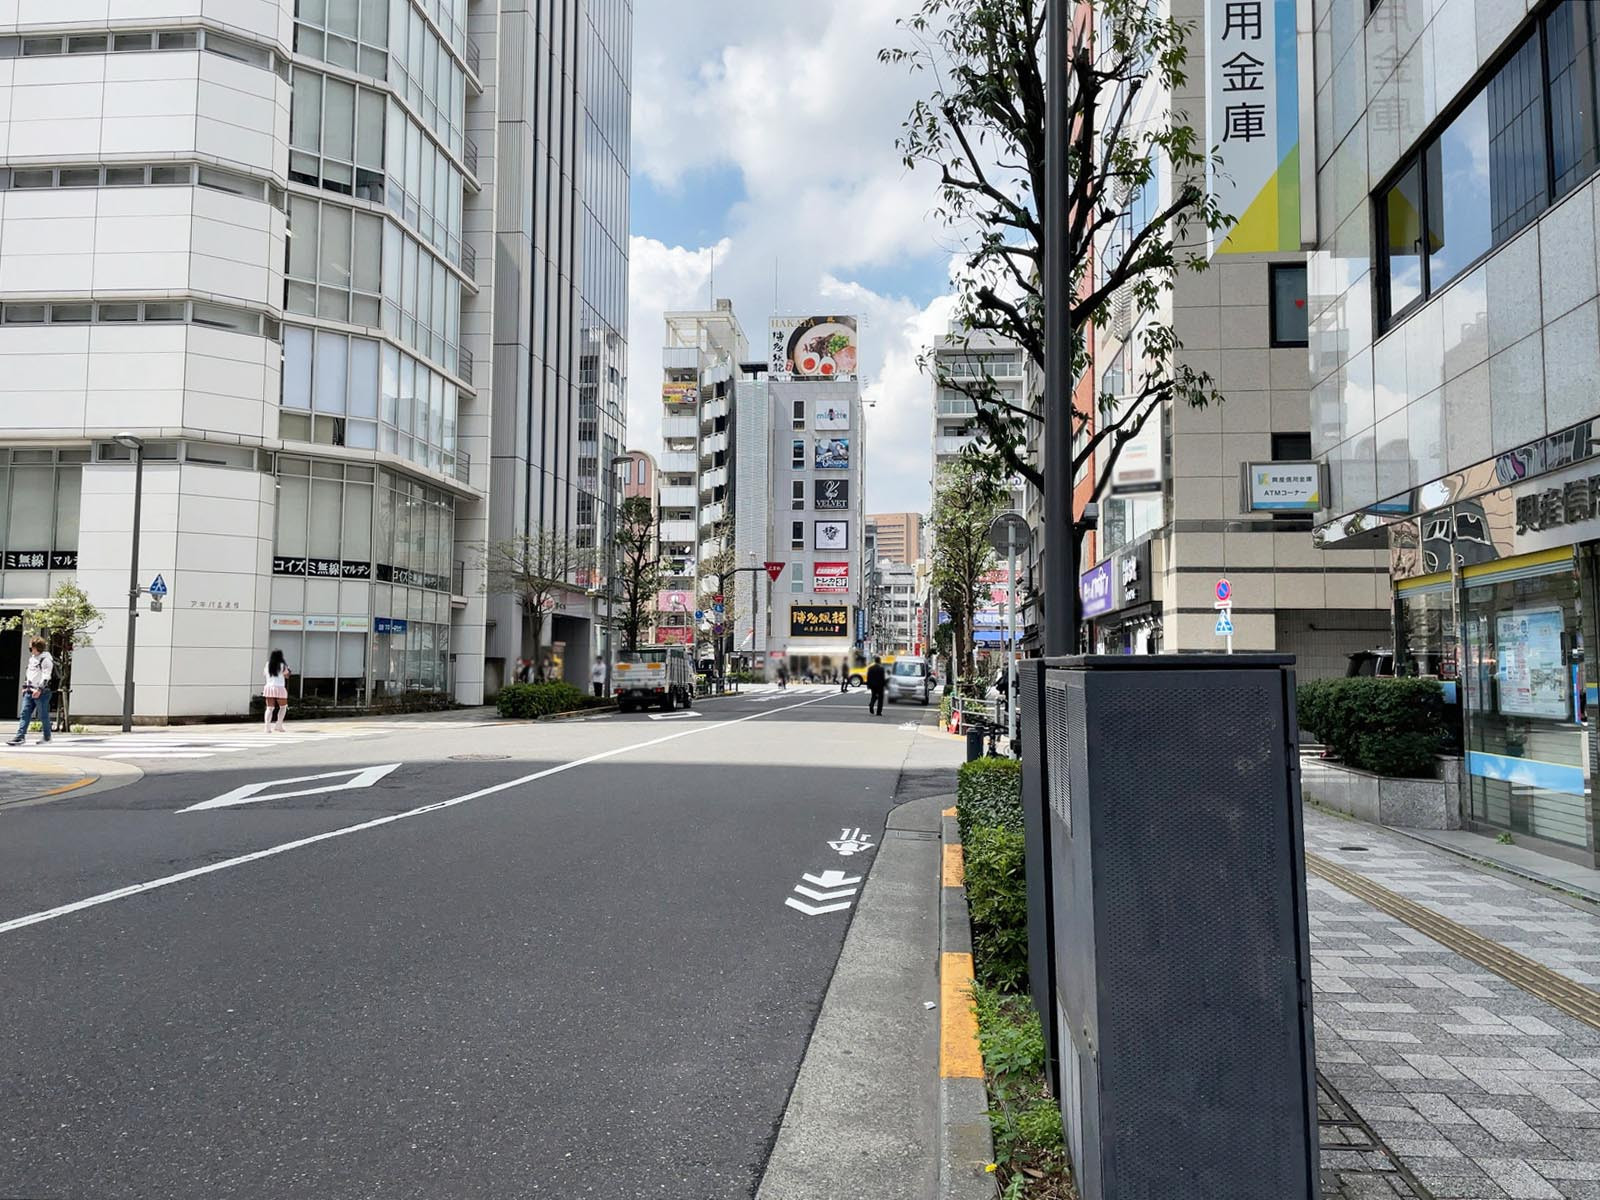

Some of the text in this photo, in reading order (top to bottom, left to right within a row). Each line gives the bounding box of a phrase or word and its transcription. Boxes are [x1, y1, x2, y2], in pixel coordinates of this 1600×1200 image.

[1221, 1, 1266, 143] 用金庫
[771, 319, 815, 328] HAKATA
[1263, 489, 1308, 497] ATMコーナー
[816, 499, 848, 507] VELVET
[0, 554, 45, 568] ミ無線
[273, 559, 371, 576] コイズミ無線 マルデン
